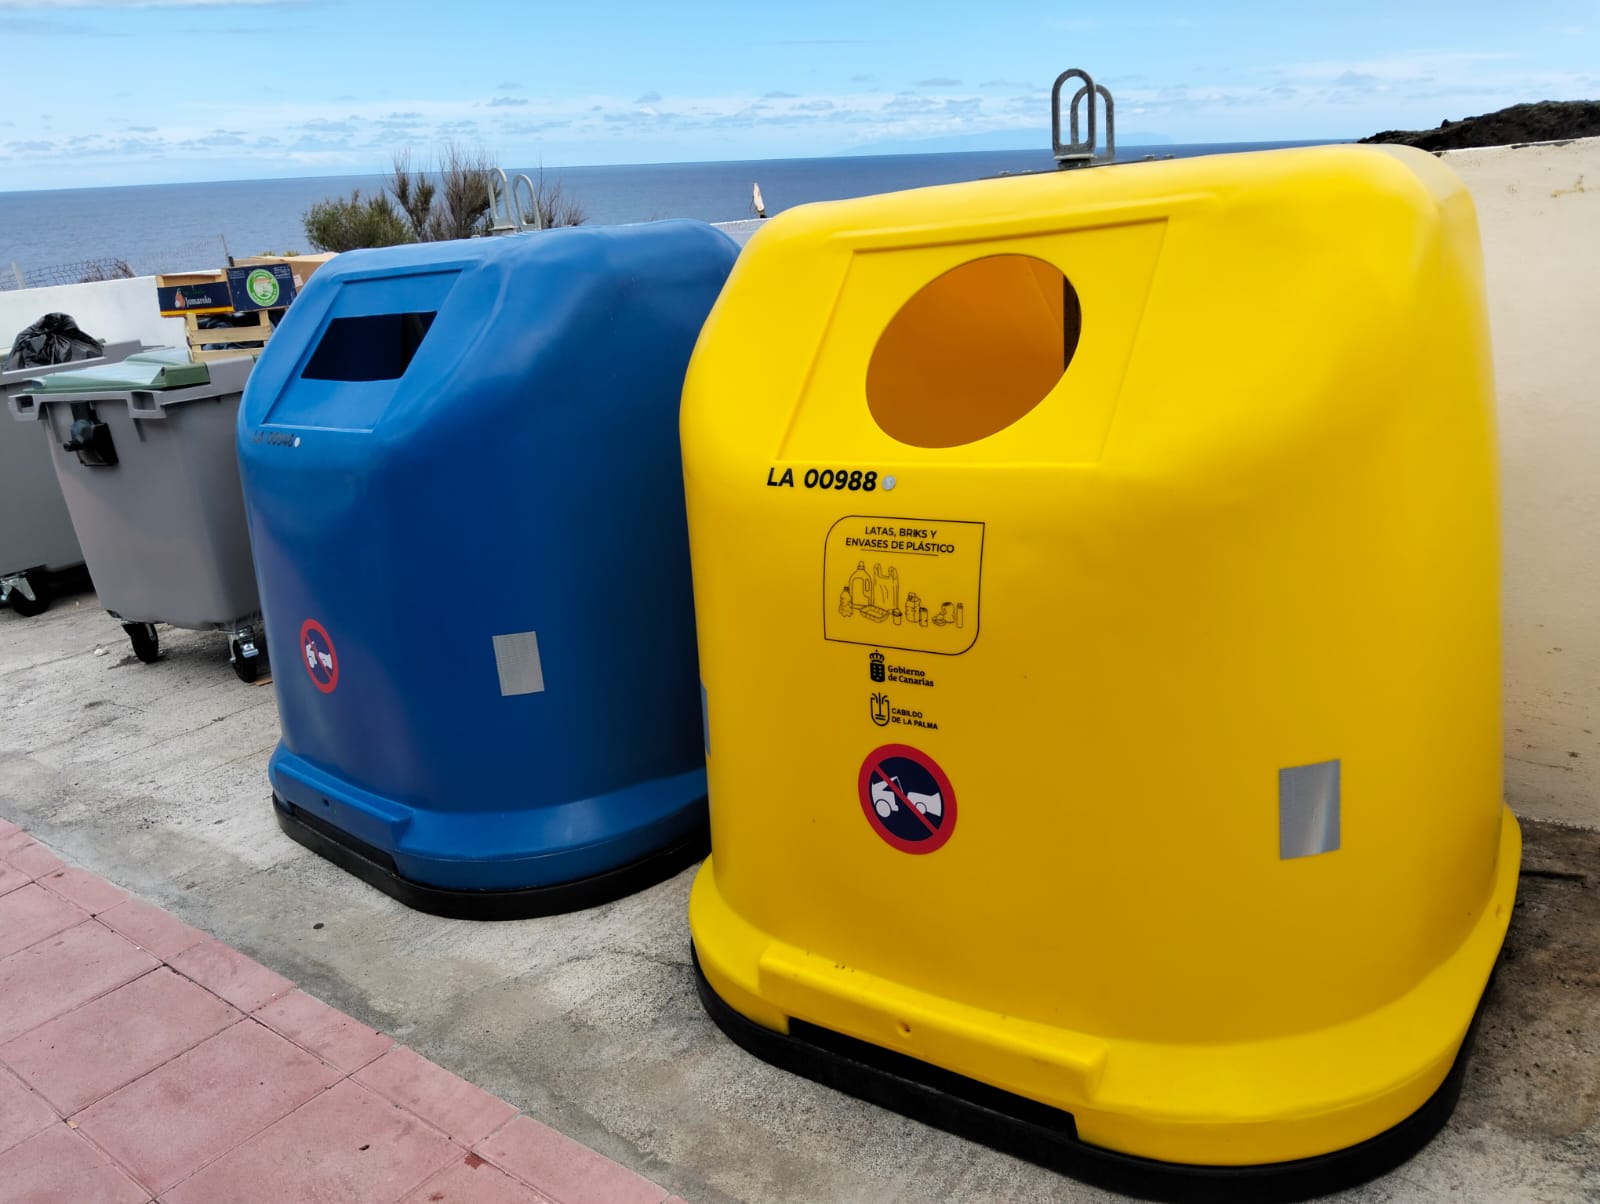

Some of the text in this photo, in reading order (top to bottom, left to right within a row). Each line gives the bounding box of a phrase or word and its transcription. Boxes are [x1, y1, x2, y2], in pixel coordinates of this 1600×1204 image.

[767, 467, 877, 491] LA 00988
[865, 526, 937, 539] LATAS, BRIKS Y
[845, 538, 954, 553] ENVASES DE PLÁSTICO
[888, 665, 925, 676] Gobierno
[899, 675, 934, 687] Canarias
[892, 708, 923, 718] CABILDO
[914, 720, 938, 729] PALMA
